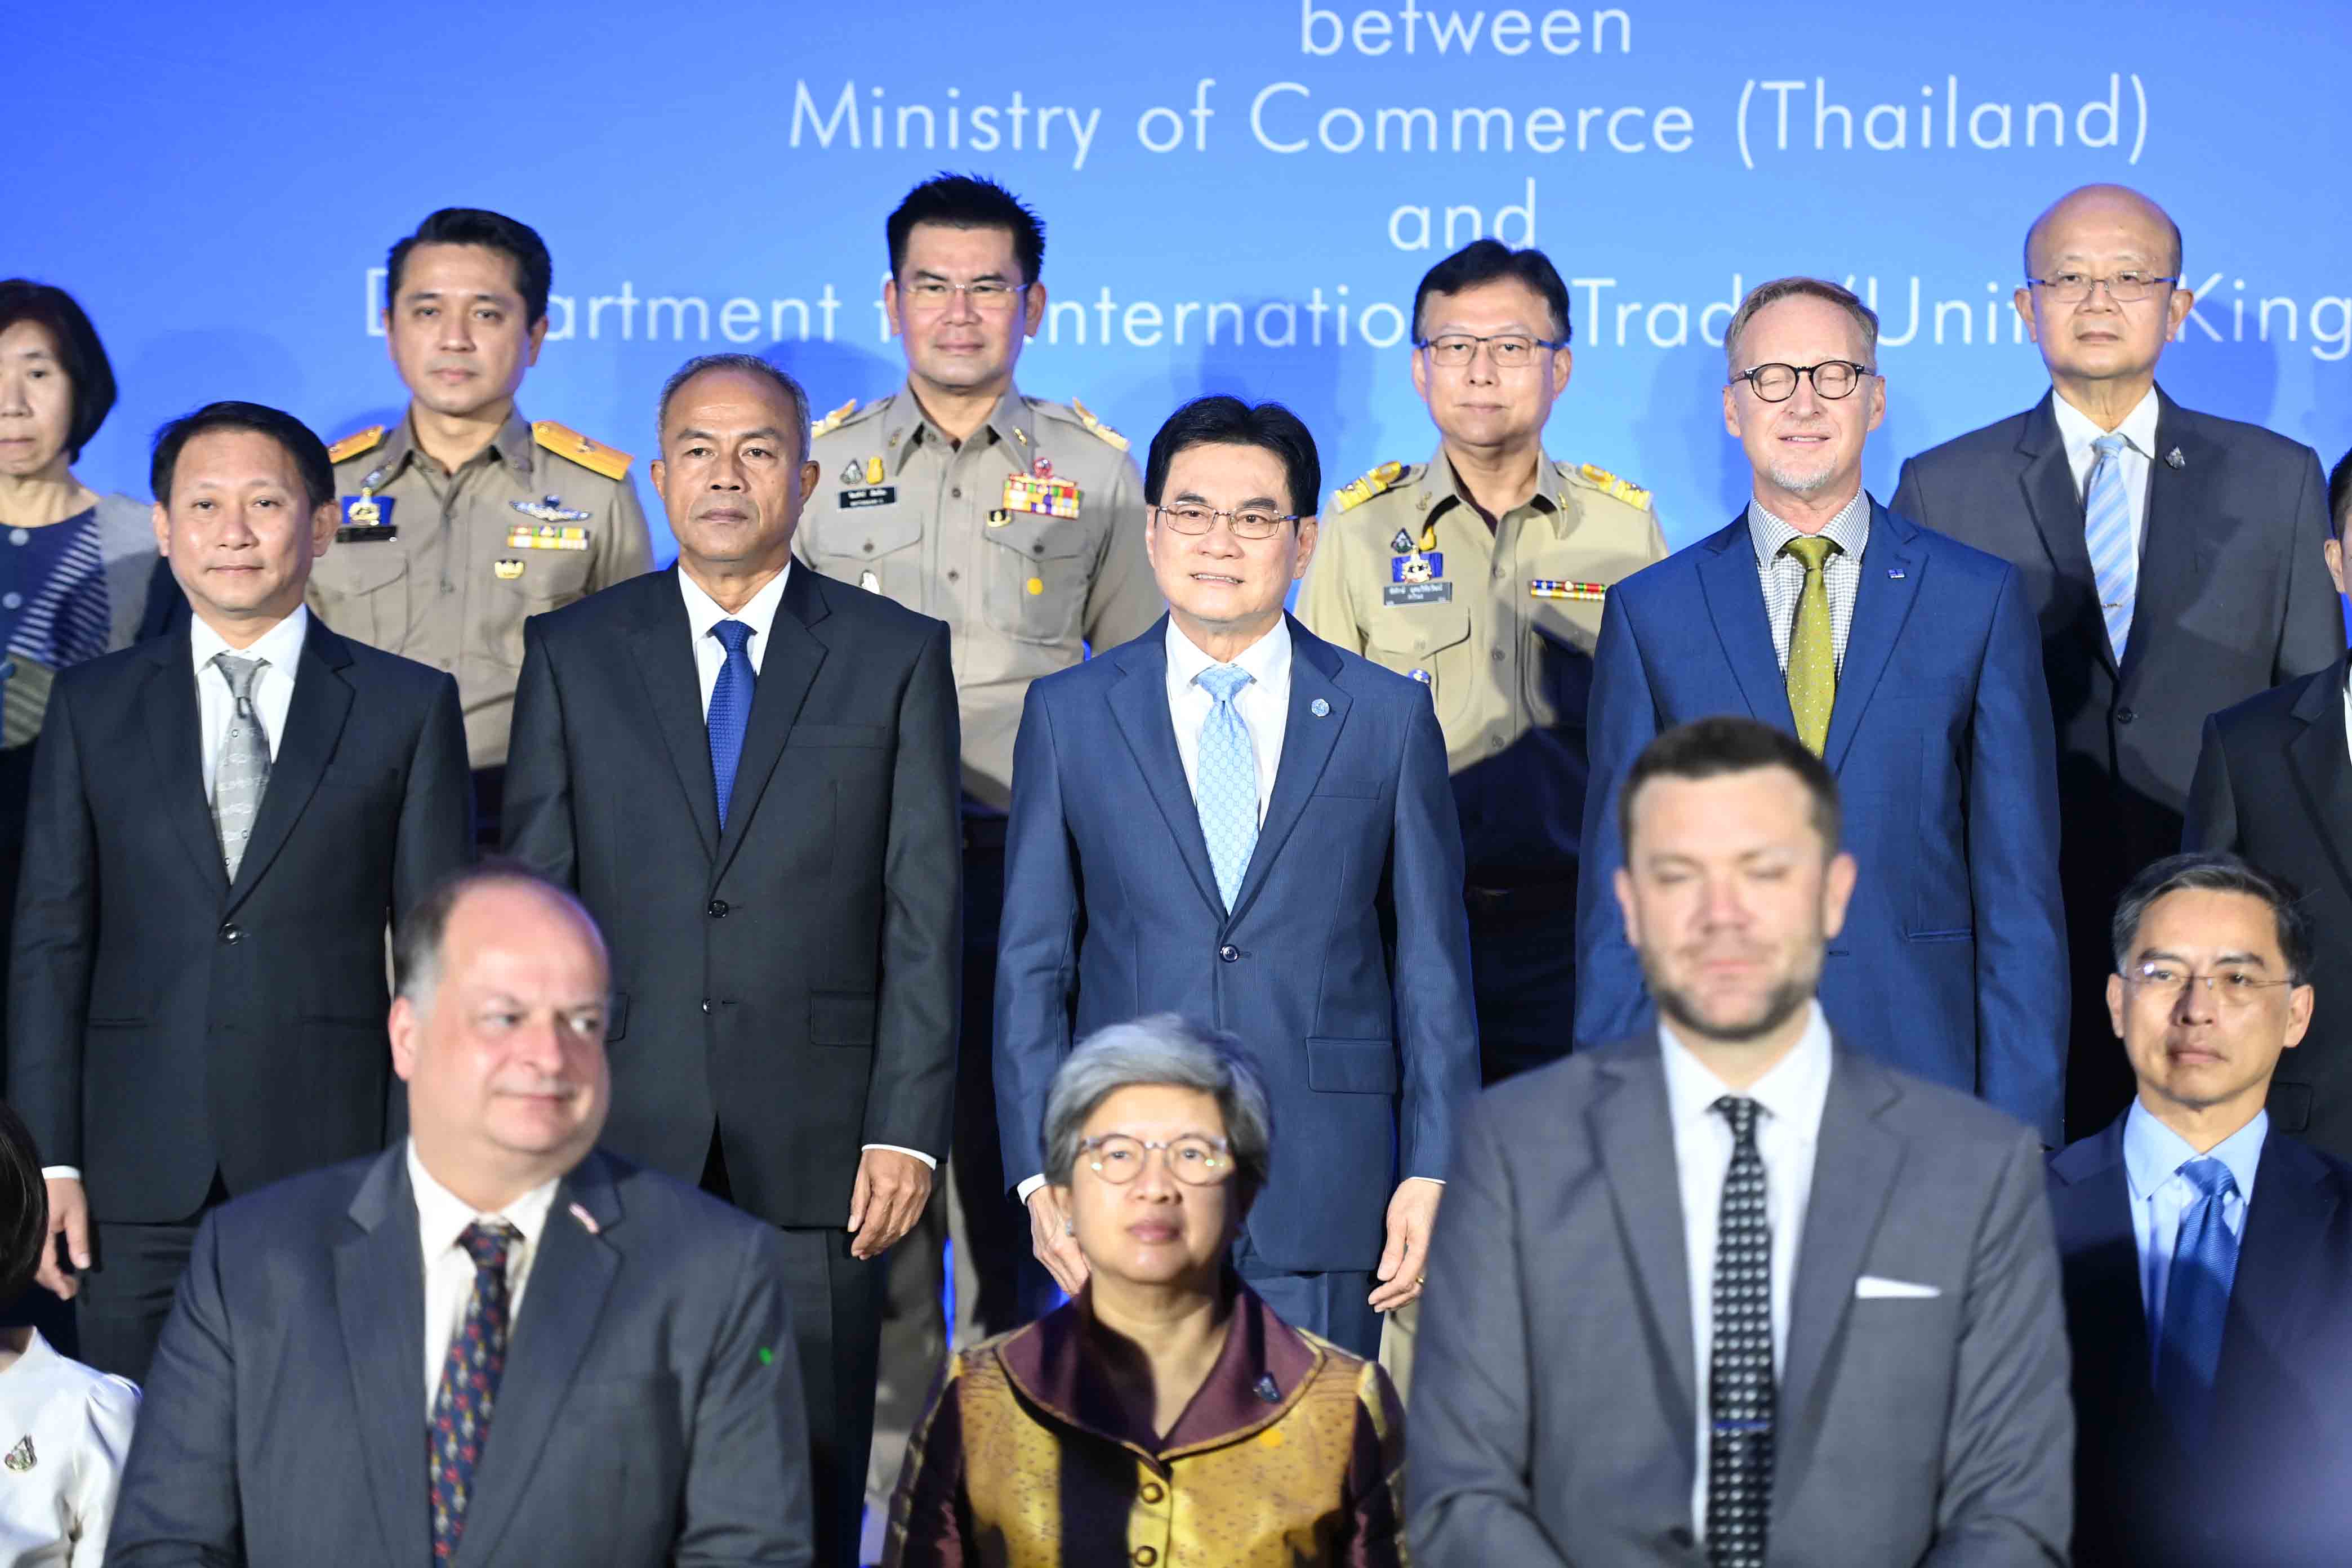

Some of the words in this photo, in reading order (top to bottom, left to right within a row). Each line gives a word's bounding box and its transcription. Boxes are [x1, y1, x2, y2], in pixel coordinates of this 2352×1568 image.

[1301, 0, 1631, 56] between
[790, 80, 1101, 171] Ministry
[1137, 78, 1216, 153] of
[1250, 82, 1695, 154] Commerce
[1737, 73, 2148, 170] (Thailand)
[1388, 176, 1536, 251] and
[366, 267, 842, 342] Dartment
[1023, 284, 1406, 349] nternatio
[1571, 273, 1744, 348] Trad
[1842, 274, 2024, 347] Unit
